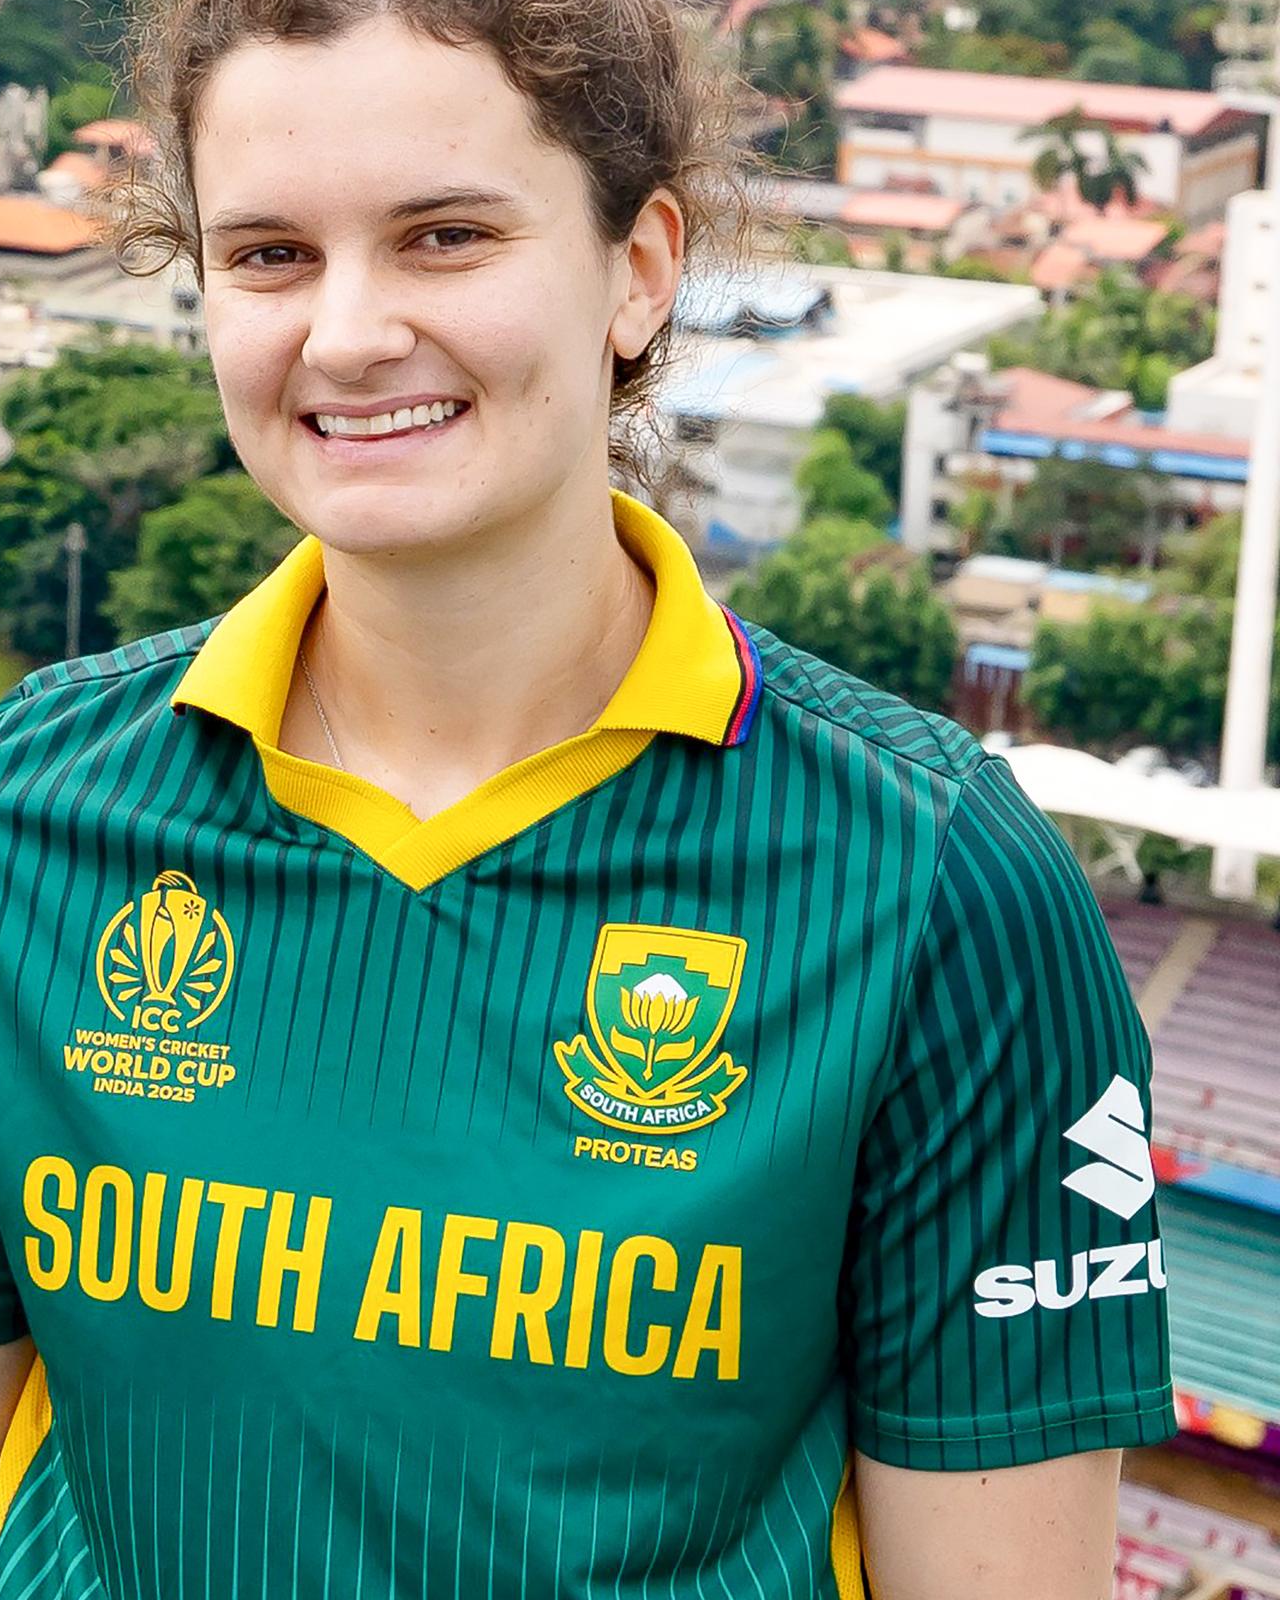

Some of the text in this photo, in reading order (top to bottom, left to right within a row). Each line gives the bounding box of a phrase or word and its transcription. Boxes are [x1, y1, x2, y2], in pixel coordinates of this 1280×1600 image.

[131, 1005, 183, 1033] ICC
[75, 1029, 230, 1060] WOMEN'S CRICKET
[63, 1045, 236, 1088] WORLD CUP
[93, 1077, 196, 1103] INDIA 2025
[580, 1083, 712, 1125] SOUTH AFRICA
[574, 1136, 698, 1171] PROTEAS
[23, 1155, 743, 1381] SOUTH AFRICA
